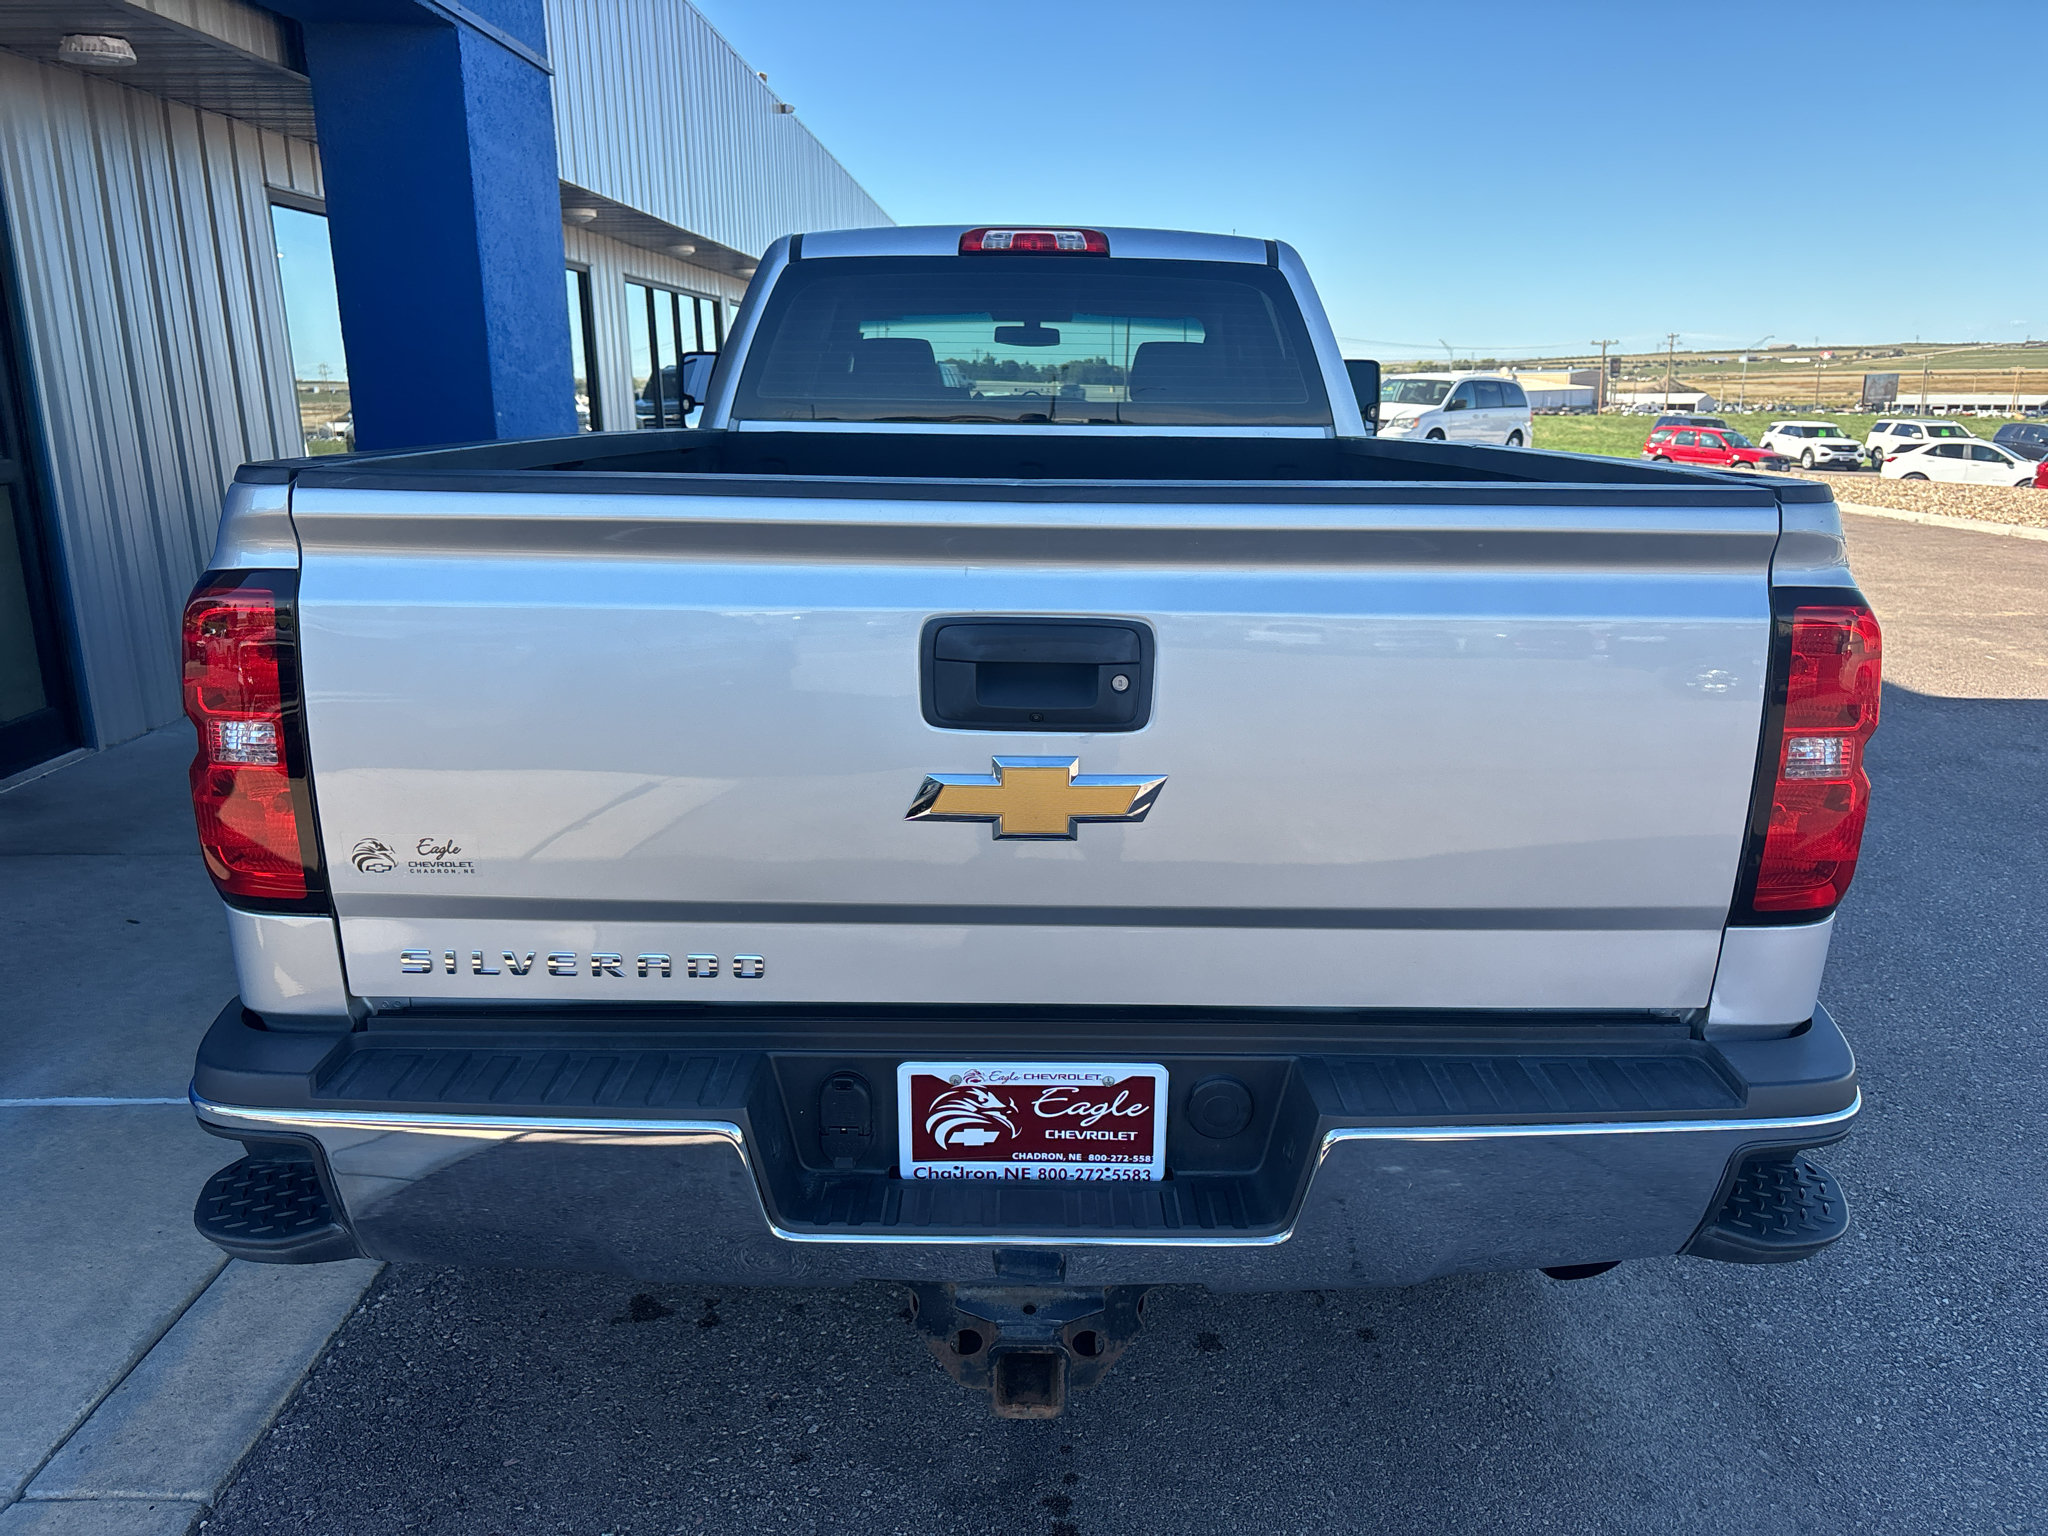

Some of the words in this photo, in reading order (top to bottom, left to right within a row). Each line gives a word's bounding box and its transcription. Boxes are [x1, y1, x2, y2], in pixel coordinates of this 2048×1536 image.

[416, 838, 462, 860] Eagle
[400, 949, 766, 979] SILVERADO
[988, 1070, 1021, 1084] Eagle
[1023, 1073, 1102, 1081] CHEVROLET
[1031, 1086, 1150, 1127] Eagle
[1045, 1129, 1138, 1141] CHEVROLET
[1012, 1152, 1066, 1162] CHADRON,
[1068, 1153, 1082, 1161] NE
[1088, 1153, 1153, 1163] 800-272-558
[1004, 1167, 1031, 1180] NE
[1037, 1167, 1151, 1181] 800-272-5583
